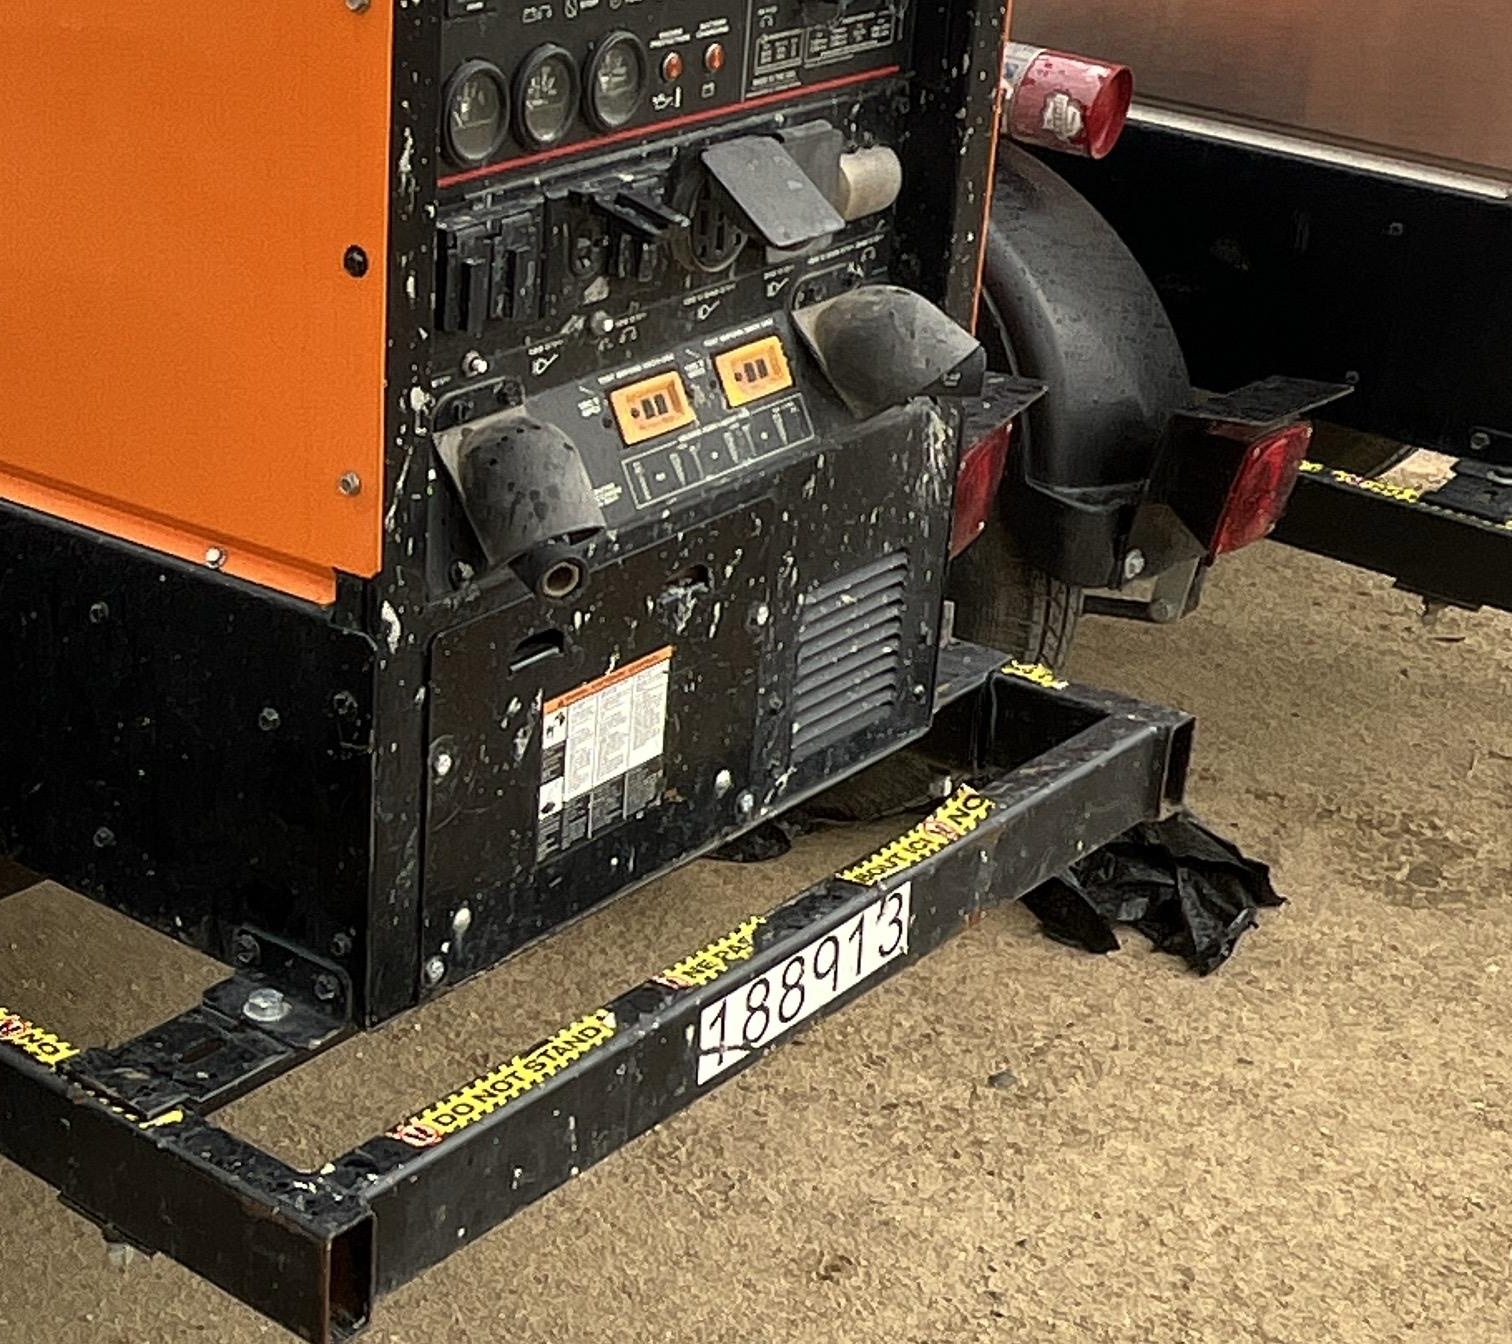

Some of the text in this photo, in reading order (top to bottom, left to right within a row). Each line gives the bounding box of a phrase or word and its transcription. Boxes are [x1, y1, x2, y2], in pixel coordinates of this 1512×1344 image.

[947, 793, 986, 826] NO
[708, 892, 904, 1067] 188913
[20, 1033, 61, 1056] NO
[432, 1025, 603, 1127] DO NOT STAND
